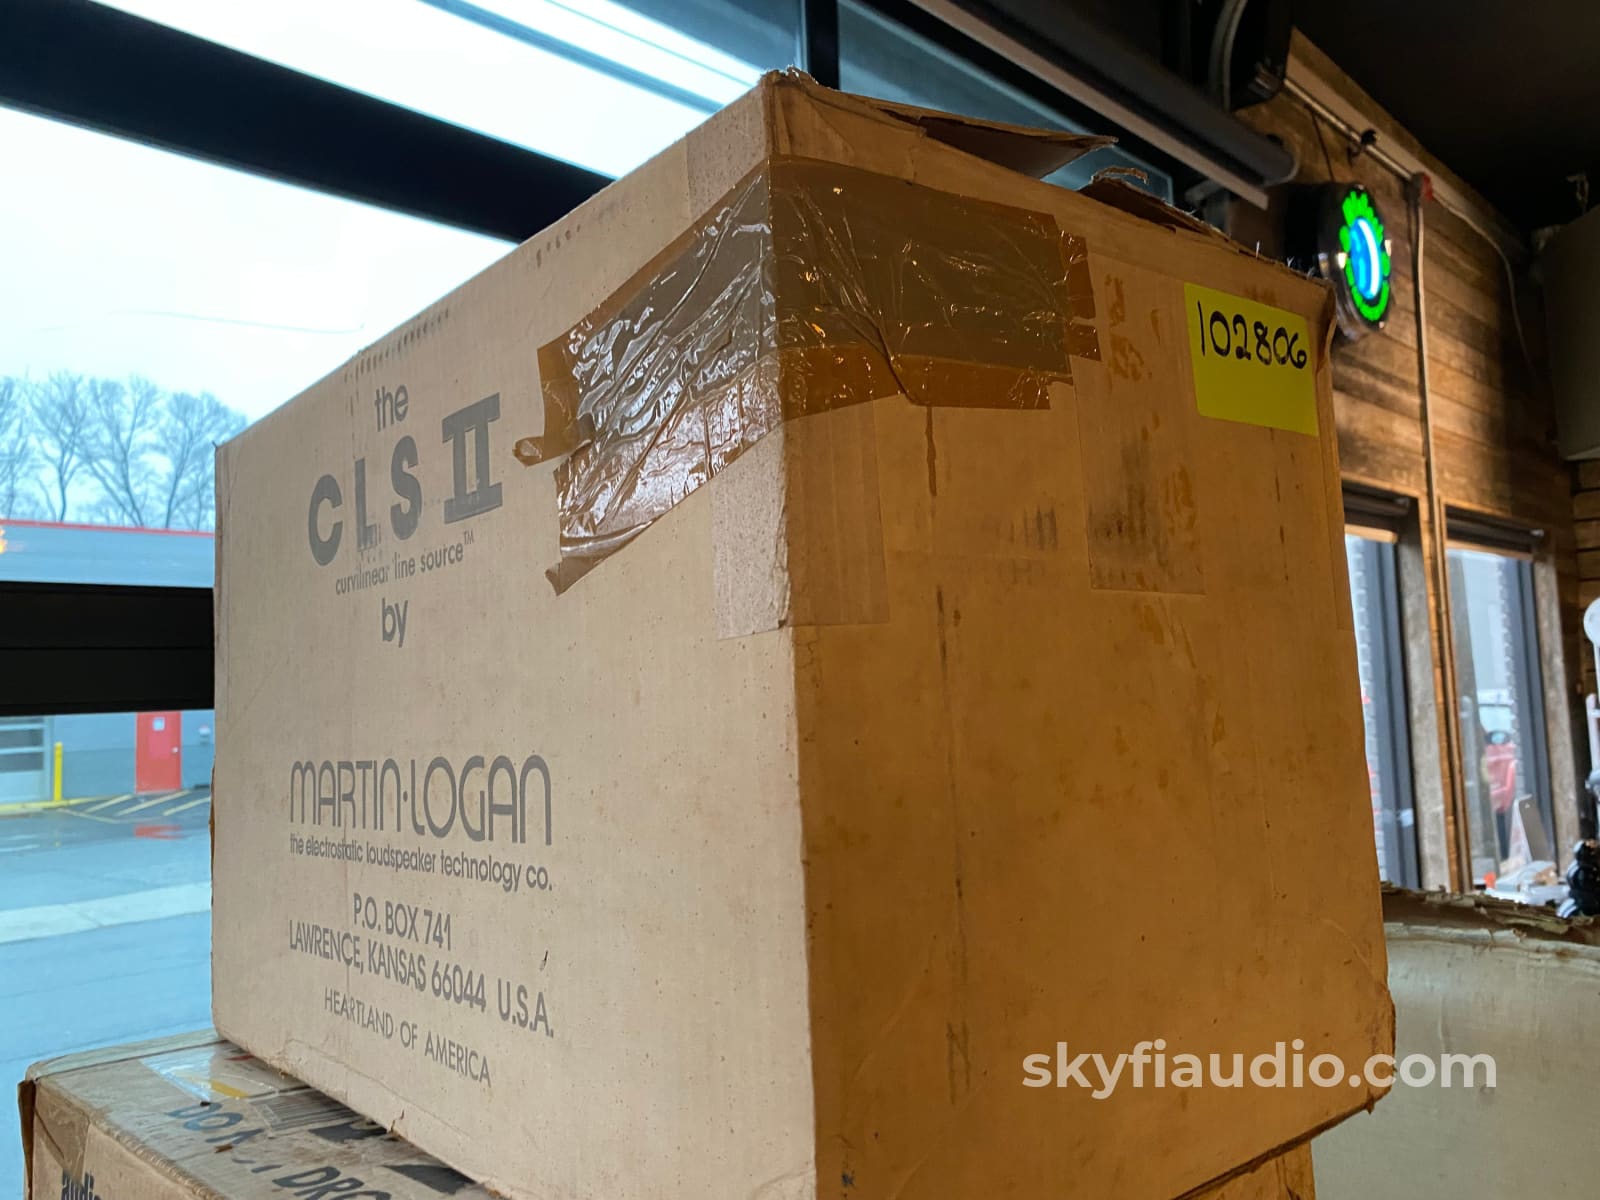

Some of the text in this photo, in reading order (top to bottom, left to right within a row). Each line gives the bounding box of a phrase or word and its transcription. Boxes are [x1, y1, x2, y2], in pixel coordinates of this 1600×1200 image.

[1197, 301, 1308, 370] 102806
[374, 384, 409, 432] the
[335, 563, 390, 596] curvilinear
[394, 551, 416, 580] line
[381, 598, 408, 648] by
[289, 832, 553, 893] the electrostatic loudspeaker technology co.
[353, 892, 452, 952] P.O. BOX 741
[289, 919, 554, 1038] LAWRENCE, KANSAS 66044 U.S.A.
[324, 986, 492, 1088] HEARTLAND OF AMERICA
